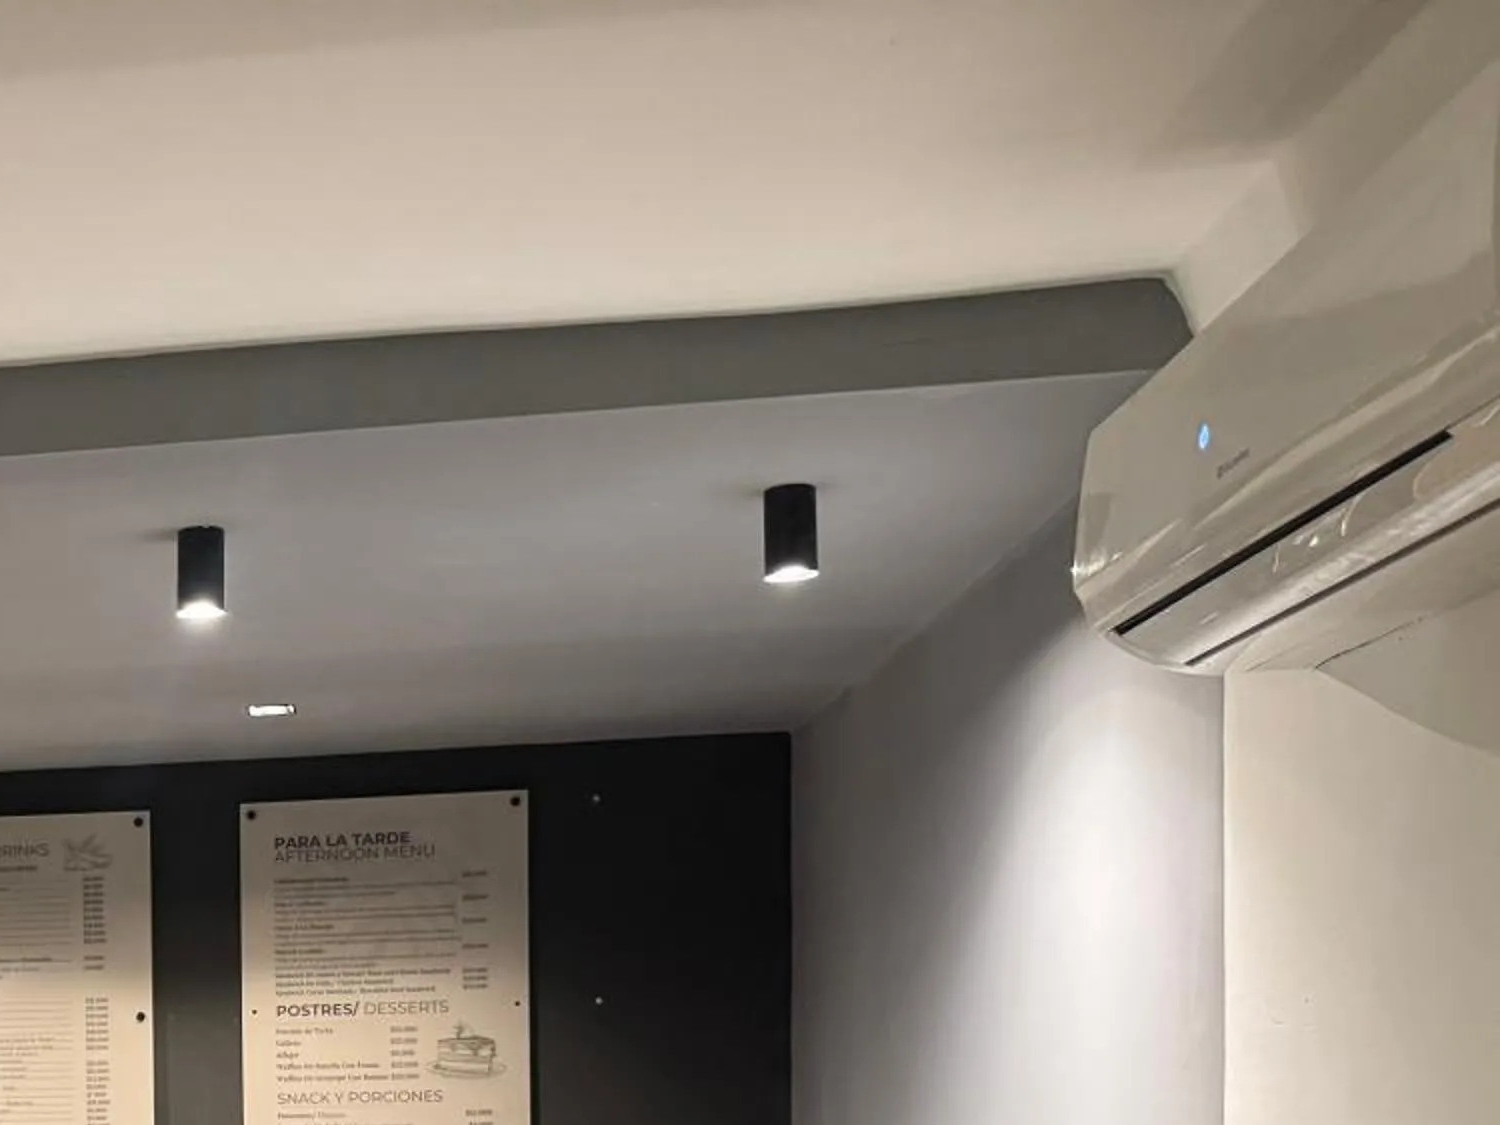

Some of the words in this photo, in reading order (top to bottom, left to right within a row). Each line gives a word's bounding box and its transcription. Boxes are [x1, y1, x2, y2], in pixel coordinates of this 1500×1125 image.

[275, 835, 321, 849] PARA
[326, 834, 348, 847] LA
[351, 831, 411, 846] TARDE
[275, 847, 379, 863] AFTERNOON
[384, 844, 435, 859] MENU
[363, 1000, 449, 1015] DESSERTS
[277, 1092, 330, 1105] SNACK
[335, 1092, 344, 1104] Y
[349, 1089, 444, 1103] PORCIONES
